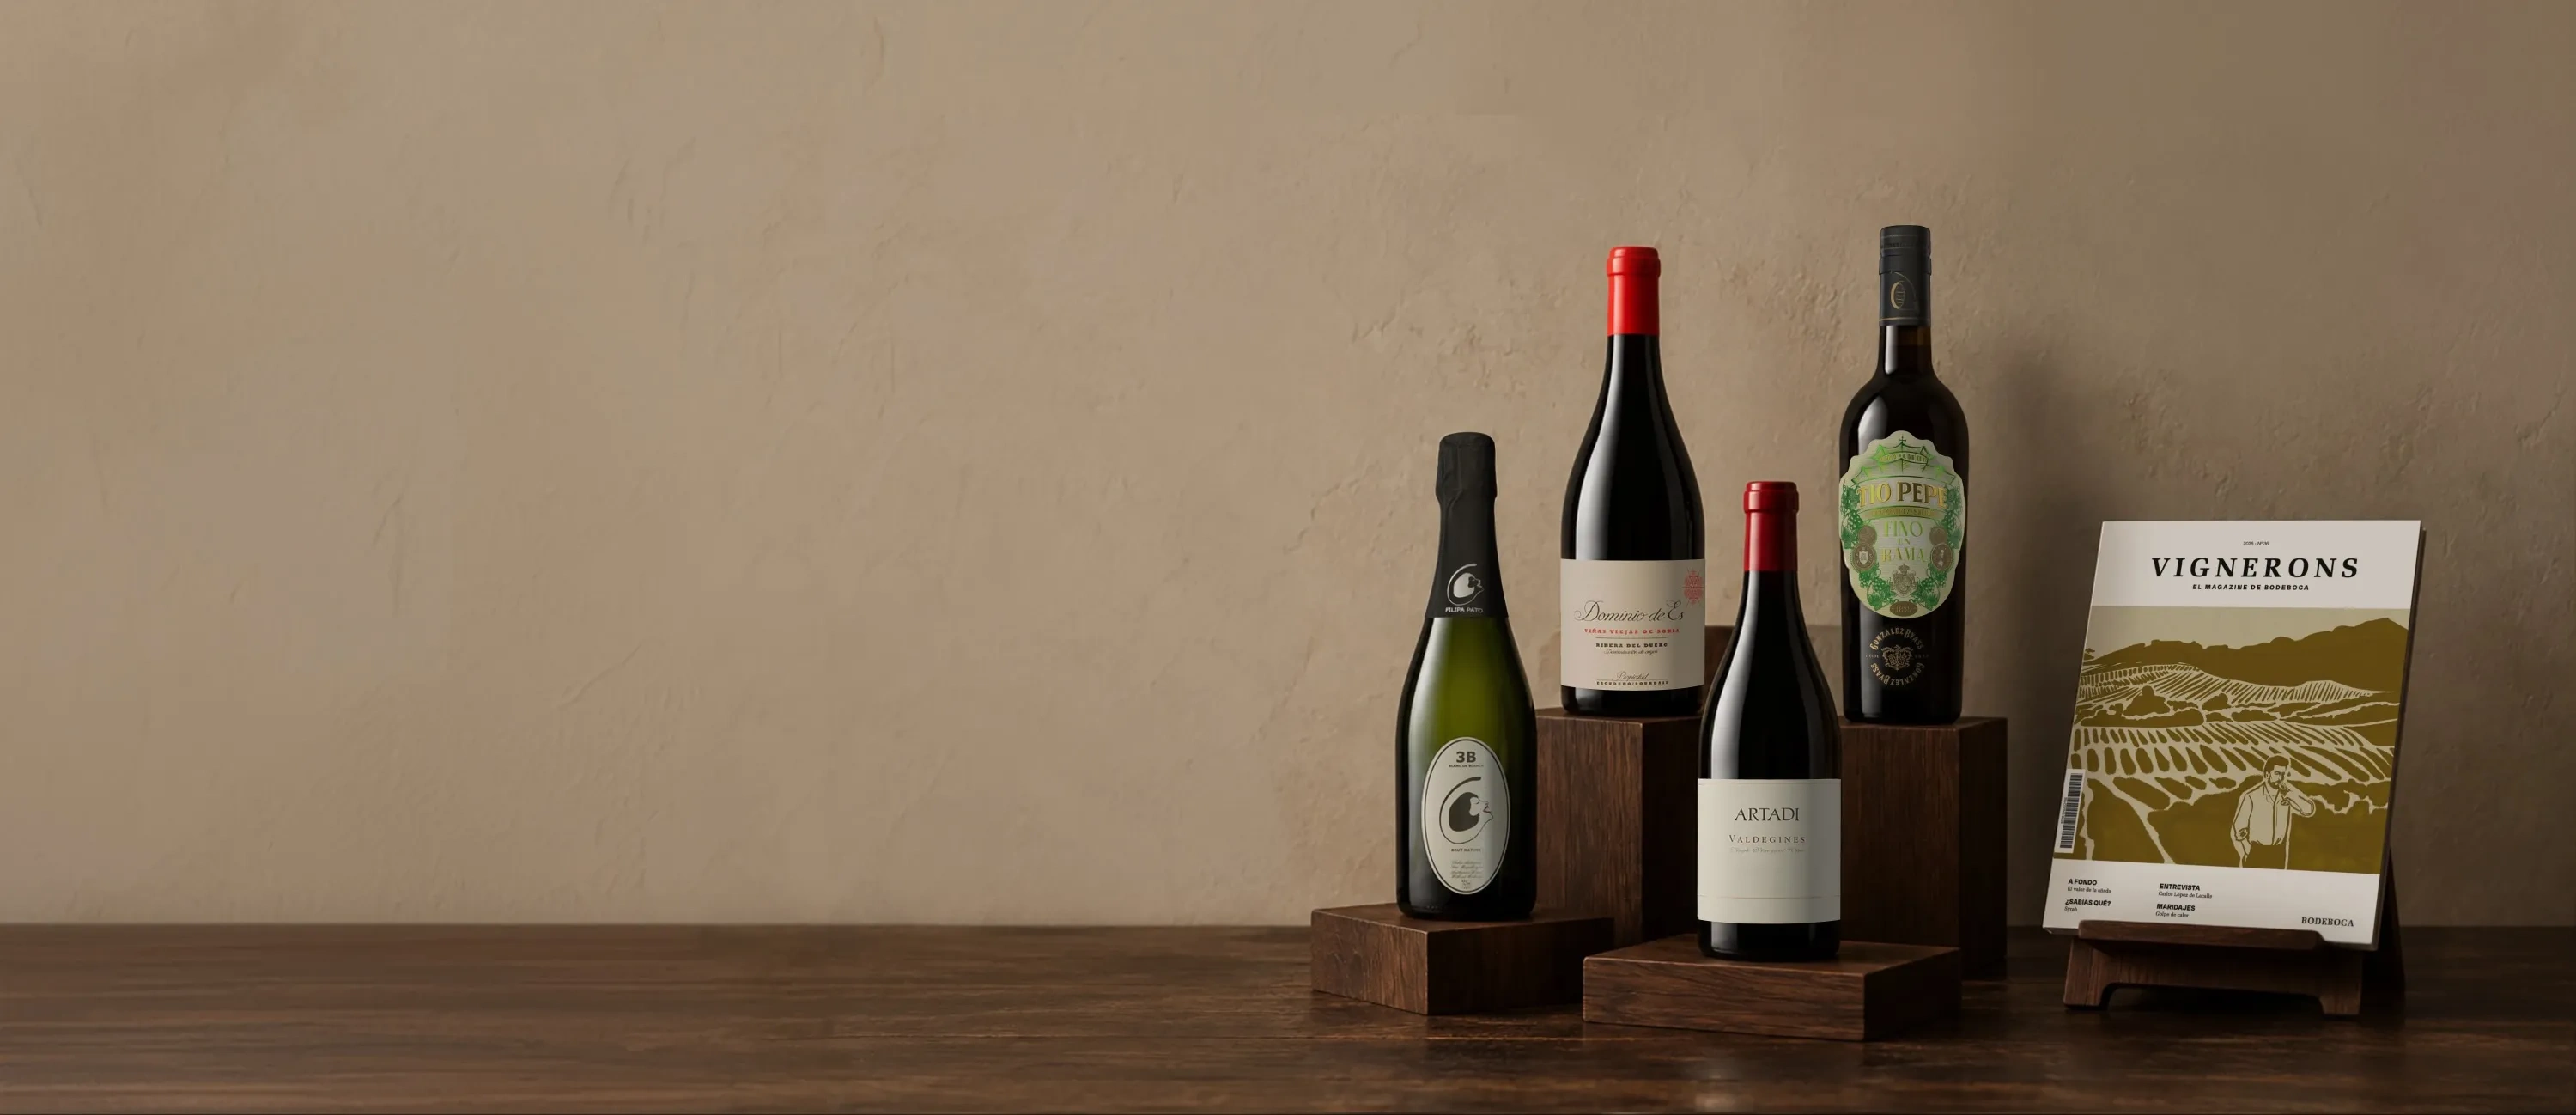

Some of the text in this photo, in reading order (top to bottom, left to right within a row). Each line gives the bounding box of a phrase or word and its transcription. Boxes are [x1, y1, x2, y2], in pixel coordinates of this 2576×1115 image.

[1896, 482, 1948, 509] PEPE
[1883, 521, 1923, 537] FINO
[1881, 547, 1925, 563] RAMA
[2152, 557, 2358, 578] VIGNERONS
[1574, 599, 1685, 622] Dominio de Es
[1455, 751, 1477, 763] 3B
[1735, 807, 1800, 821] ARTADI
[1729, 834, 1806, 844] VALDEGINES
[2156, 903, 2196, 911] MARIDAJES
[2300, 917, 2354, 927] BODEBOCA
